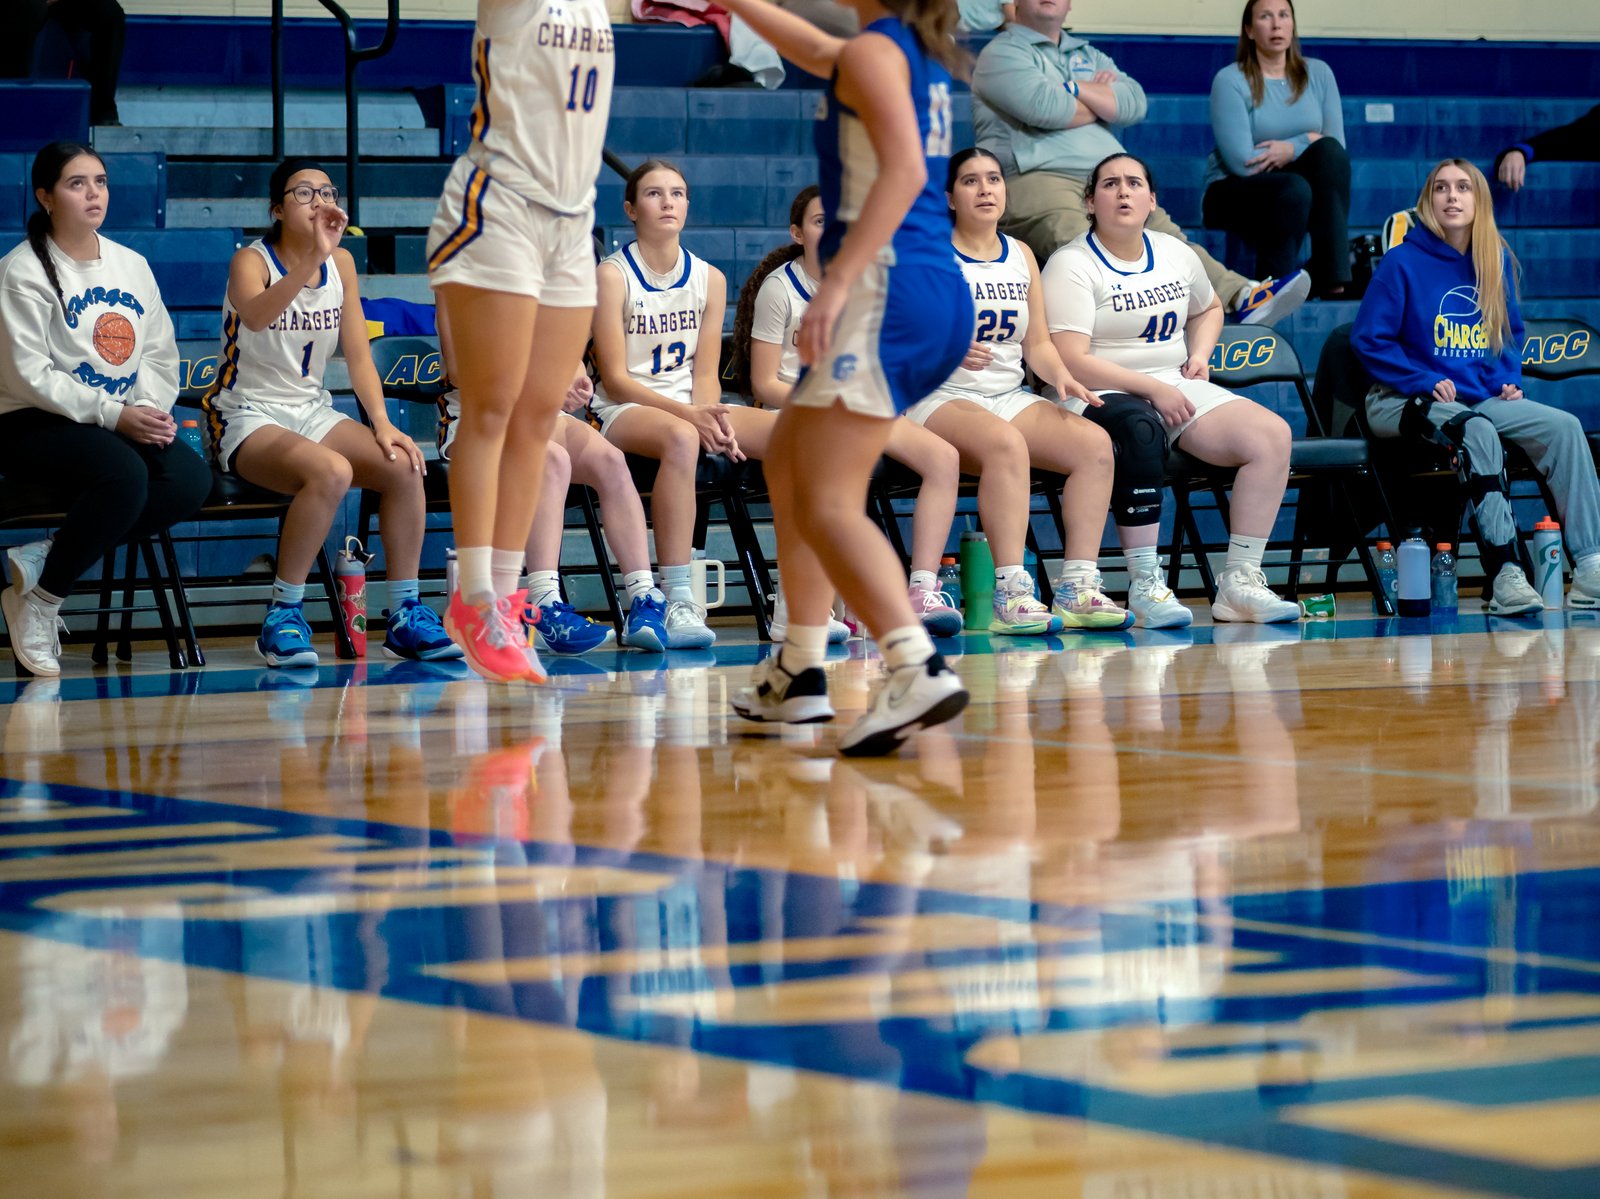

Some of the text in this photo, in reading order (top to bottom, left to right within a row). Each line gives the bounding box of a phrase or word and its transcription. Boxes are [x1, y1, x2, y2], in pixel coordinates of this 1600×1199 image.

[566, 63, 598, 112] 10
[968, 282, 1028, 301] ARGERS
[1112, 280, 1186, 312] CHARGERS
[268, 306, 343, 331] HARGER
[628, 309, 701, 335] CHARGER
[976, 309, 1018, 342] 25
[1137, 310, 1178, 343] 40
[301, 341, 314, 378] 1
[651, 341, 687, 376] 13
[1208, 336, 1277, 371] ACC
[1521, 330, 1591, 365] ACC
[384, 352, 442, 385] AC
